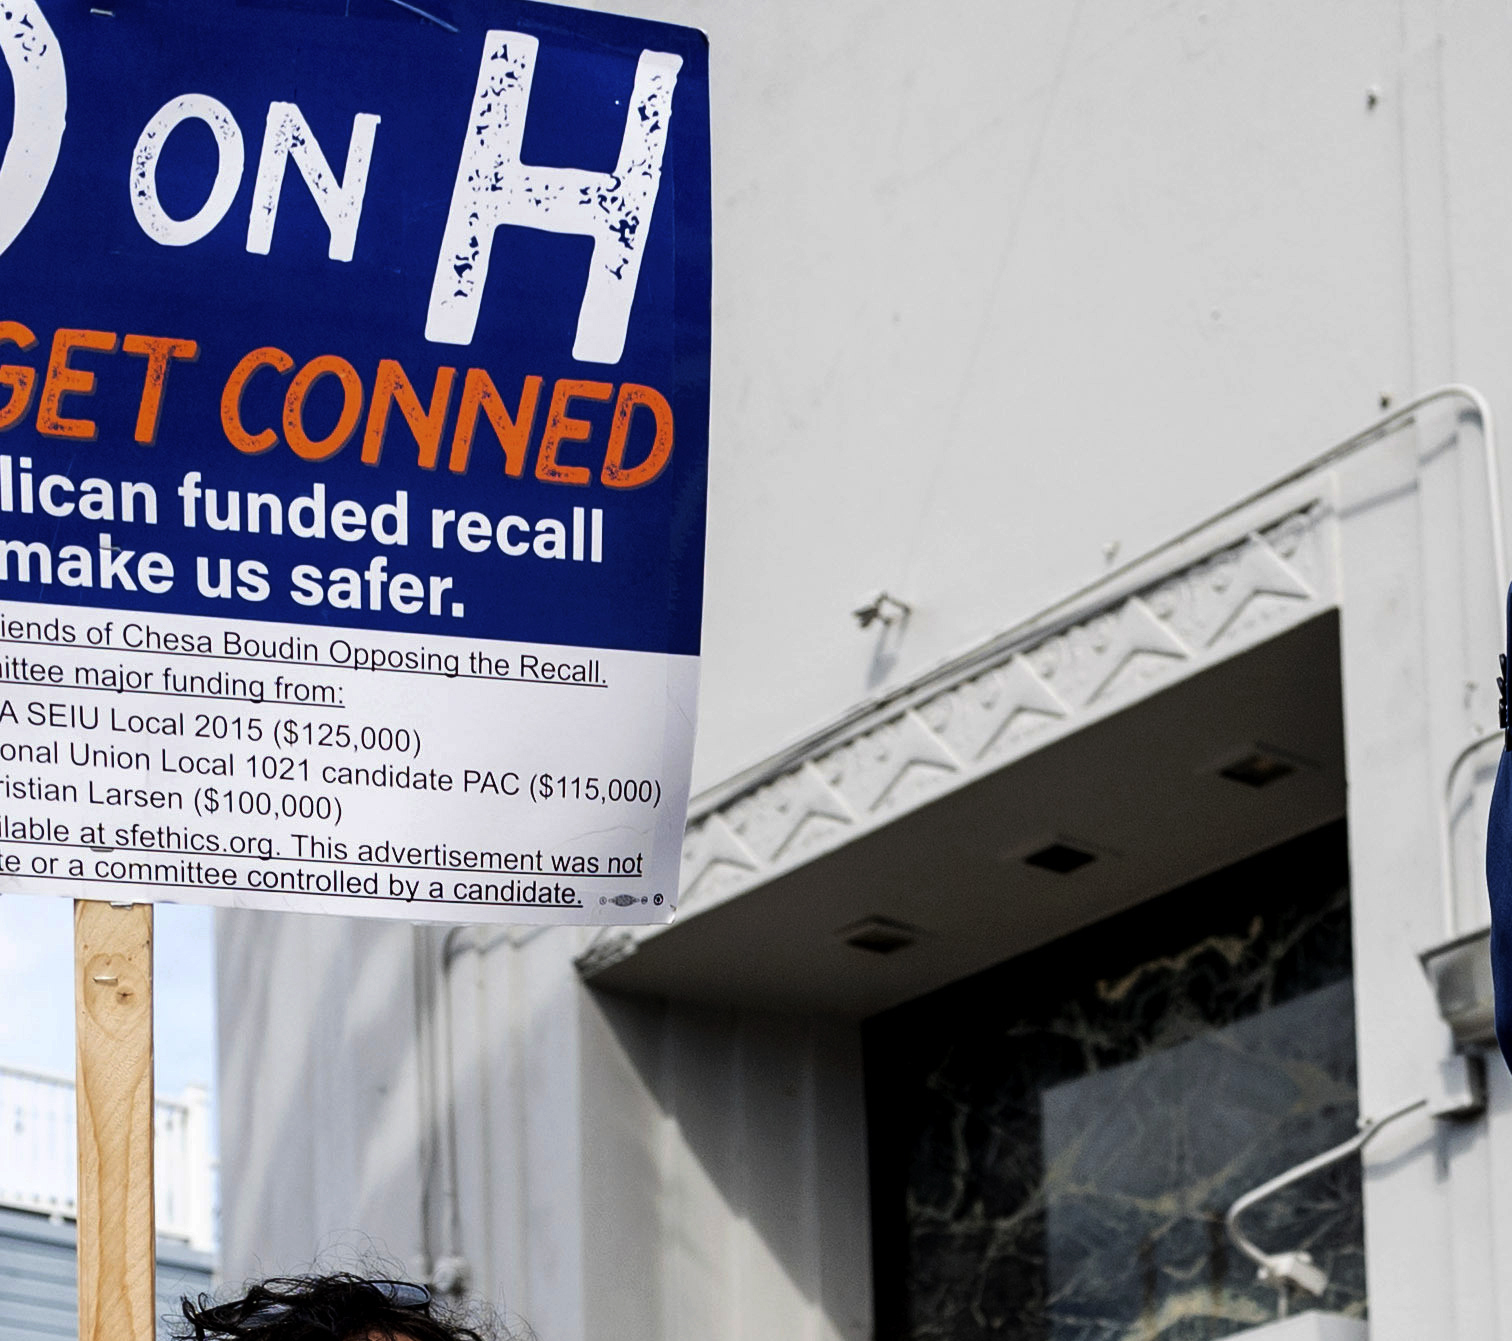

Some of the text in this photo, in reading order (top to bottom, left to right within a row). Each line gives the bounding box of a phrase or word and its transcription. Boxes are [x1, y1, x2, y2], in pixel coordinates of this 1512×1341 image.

[128, 92, 381, 263] ON
[423, 29, 685, 364] H
[220, 346, 674, 488] CONNED
[177, 471, 408, 546] funded
[431, 506, 603, 563] recall
[196, 556, 271, 602] us
[287, 555, 465, 618] safer.
[75, 664, 154, 694] major
[162, 667, 264, 704] funding
[275, 675, 343, 704] from:
[86, 621, 114, 646] of
[122, 623, 212, 654] Chesa
[224, 631, 318, 662] Boudin
[329, 639, 459, 679] Opposing
[469, 651, 510, 677] the
[520, 654, 606, 684] Recall.
[27, 702, 99, 731] SEIU
[111, 707, 184, 736] Local
[195, 714, 263, 742] 2015
[273, 719, 421, 759] ($125,000)
[70, 742, 150, 771] Union
[161, 748, 234, 777] Local
[247, 755, 309, 781] 1021
[322, 763, 453, 792] candidate
[464, 769, 520, 796] PAC
[529, 773, 662, 809] ($115,000)
[89, 780, 183, 810] Larsen
[194, 787, 342, 826] ($100,000)
[31, 856, 59, 875] or
[68, 859, 84, 877] a
[95, 860, 237, 886] committee
[247, 869, 378, 895] controlled
[389, 873, 420, 903] by
[428, 881, 444, 899] a
[453, 879, 583, 905] candidate.
[80, 822, 106, 845] at
[115, 824, 281, 861] sfethics.org.
[290, 833, 348, 860] This
[358, 840, 543, 872] advertisement
[550, 855, 599, 874] was
[607, 852, 644, 878] not
